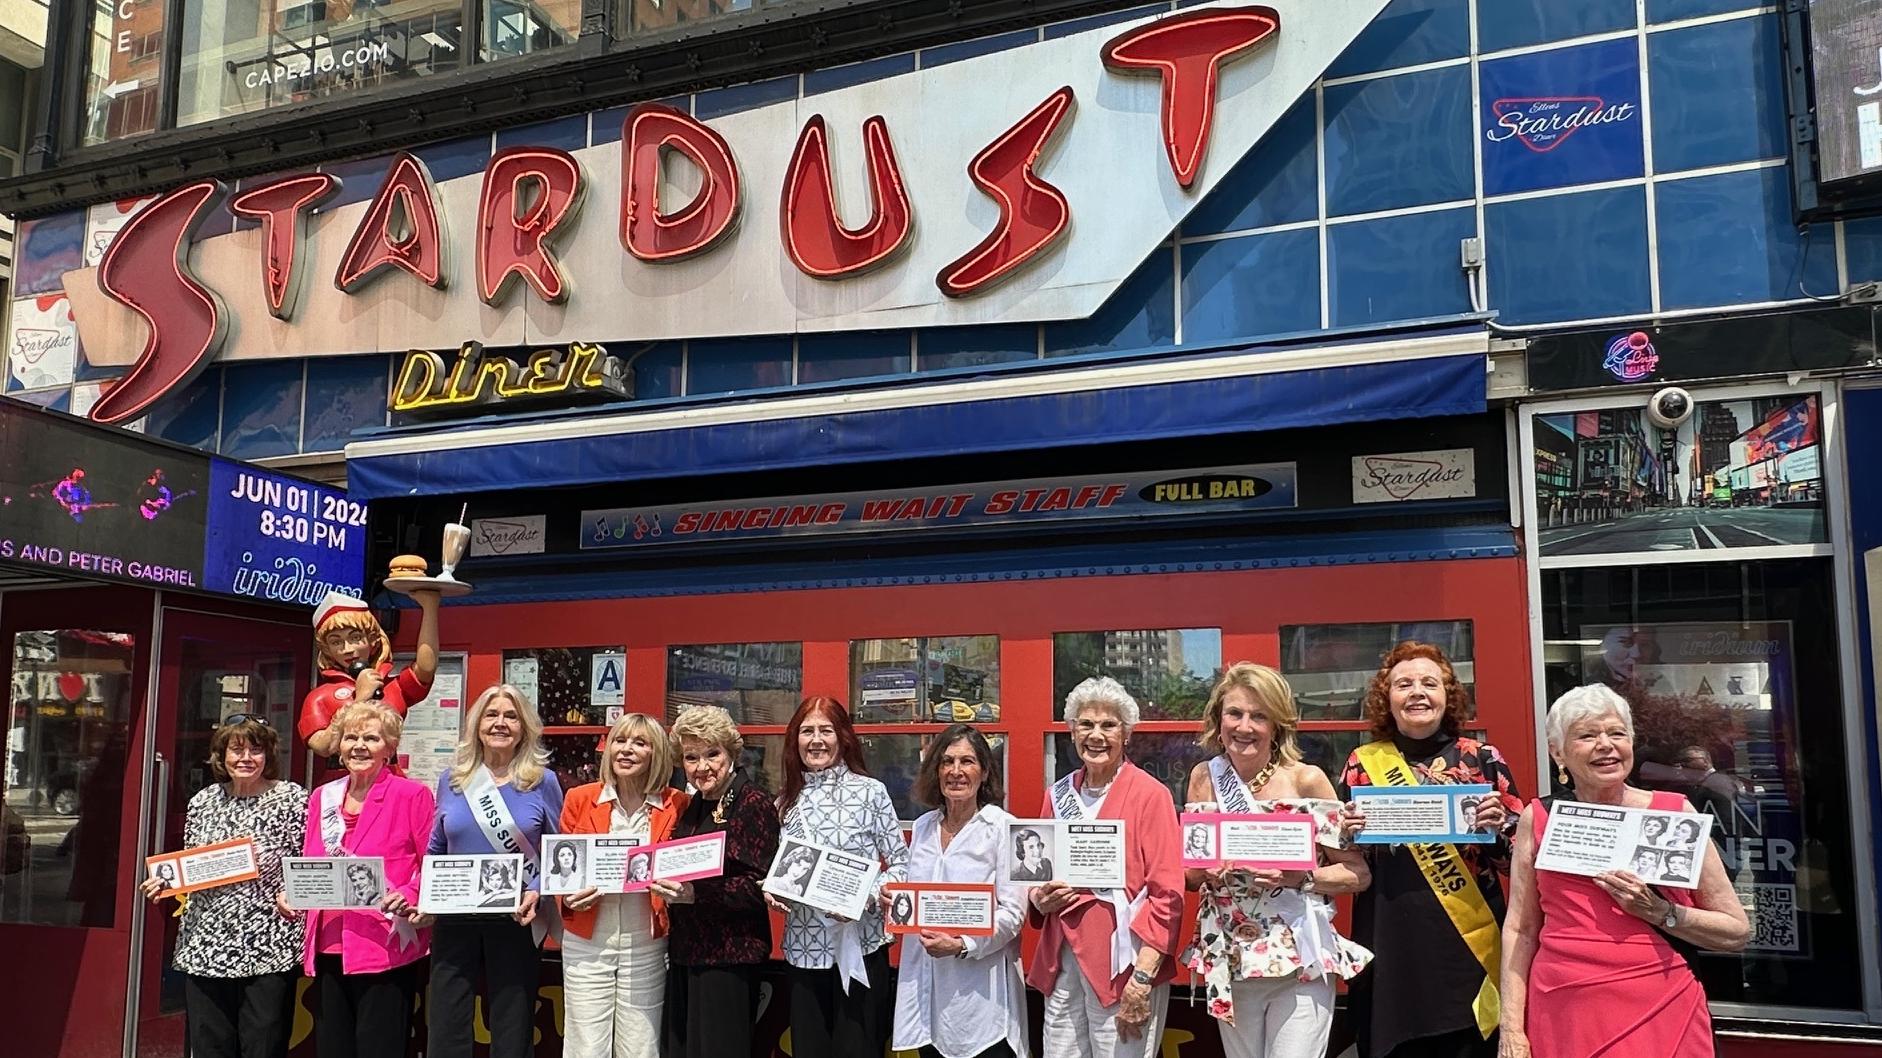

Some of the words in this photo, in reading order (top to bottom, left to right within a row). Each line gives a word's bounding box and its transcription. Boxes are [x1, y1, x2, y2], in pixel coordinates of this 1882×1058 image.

[245, 42, 389, 89] CAPEZIO.COM
[1487, 102, 1636, 141] Stardust
[88, 5, 1281, 425] STARDUST
[231, 474, 281, 503] JUN
[286, 487, 308, 513] 01
[1155, 481, 1203, 503] FULL
[1208, 478, 1256, 499] BAR
[1361, 464, 1464, 488] Stardust
[672, 501, 848, 534] SINGING
[861, 491, 977, 523] WAIT
[983, 483, 1129, 515] STAFF
[260, 510, 308, 542] 8:30
[313, 522, 347, 551] PM
[20, 546, 63, 566] AND
[68, 551, 123, 577] PETER
[128, 561, 197, 588] GABRIEL
[597, 660, 621, 691] A
[1384, 766, 1409, 786] MI
[479, 794, 502, 828] MISS
[1426, 842, 1467, 892] WAYS
